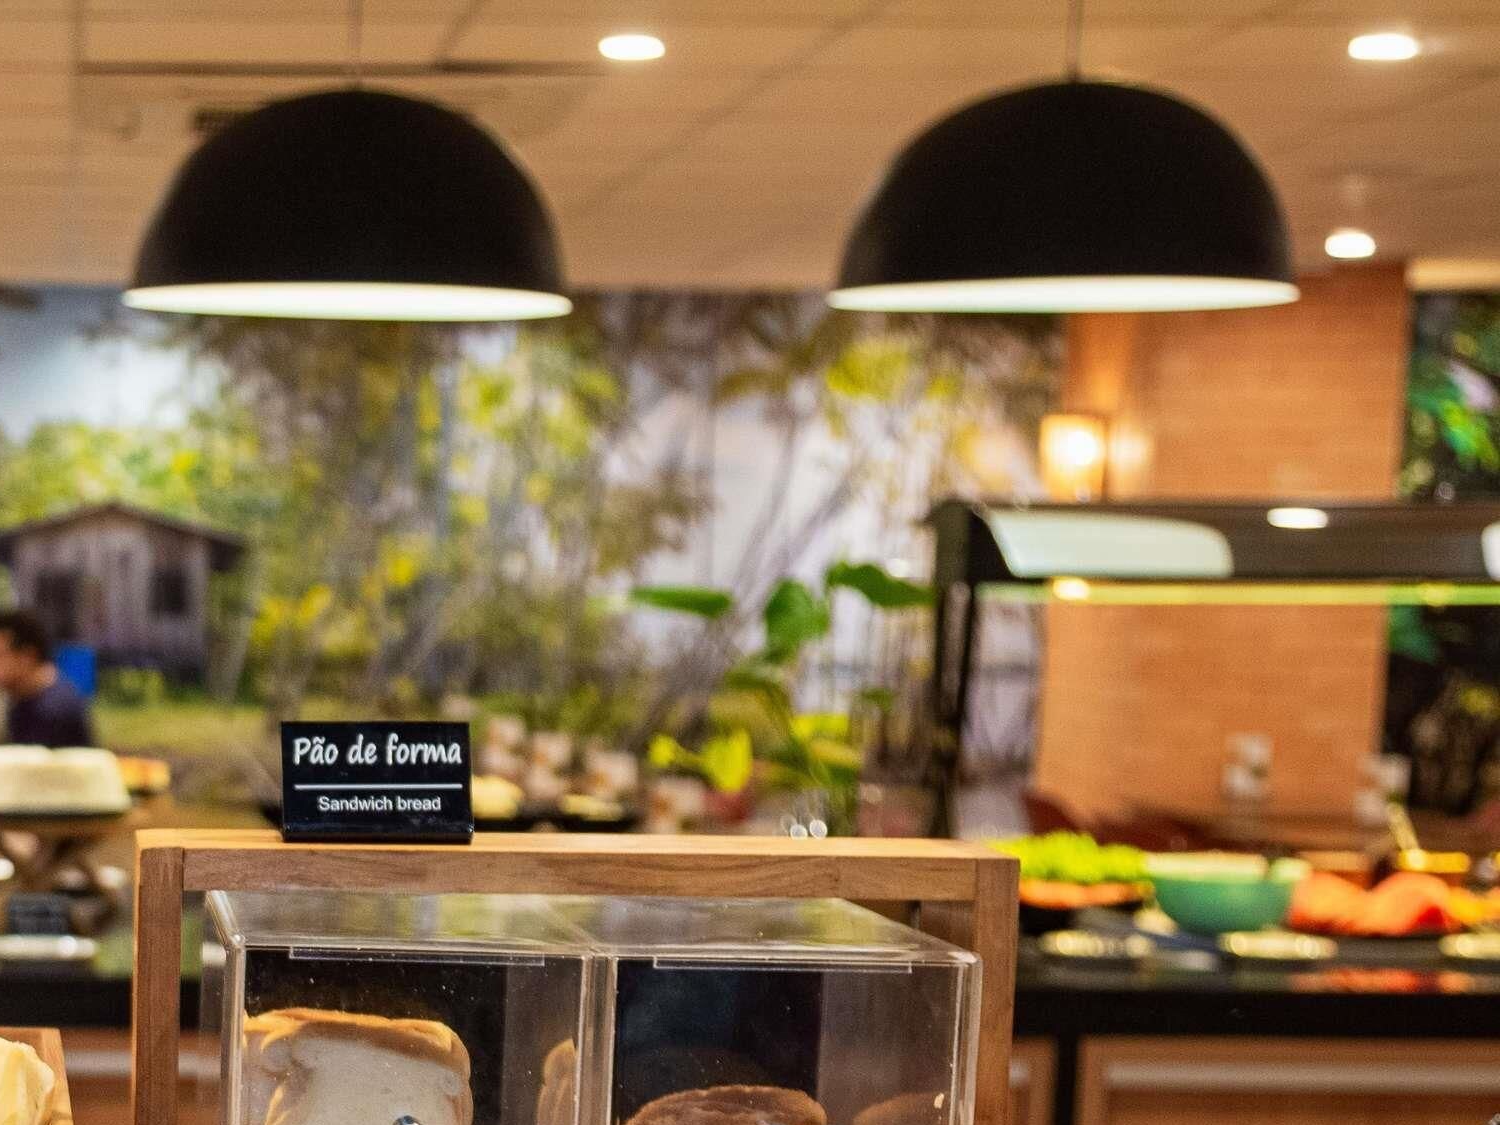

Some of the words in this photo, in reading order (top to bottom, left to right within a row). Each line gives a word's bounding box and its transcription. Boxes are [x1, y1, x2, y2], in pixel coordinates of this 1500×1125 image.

[293, 736, 339, 765] Pão
[347, 733, 378, 765] de
[385, 732, 462, 765] forma
[317, 795, 394, 812] Sandwich
[395, 795, 442, 812] bread
